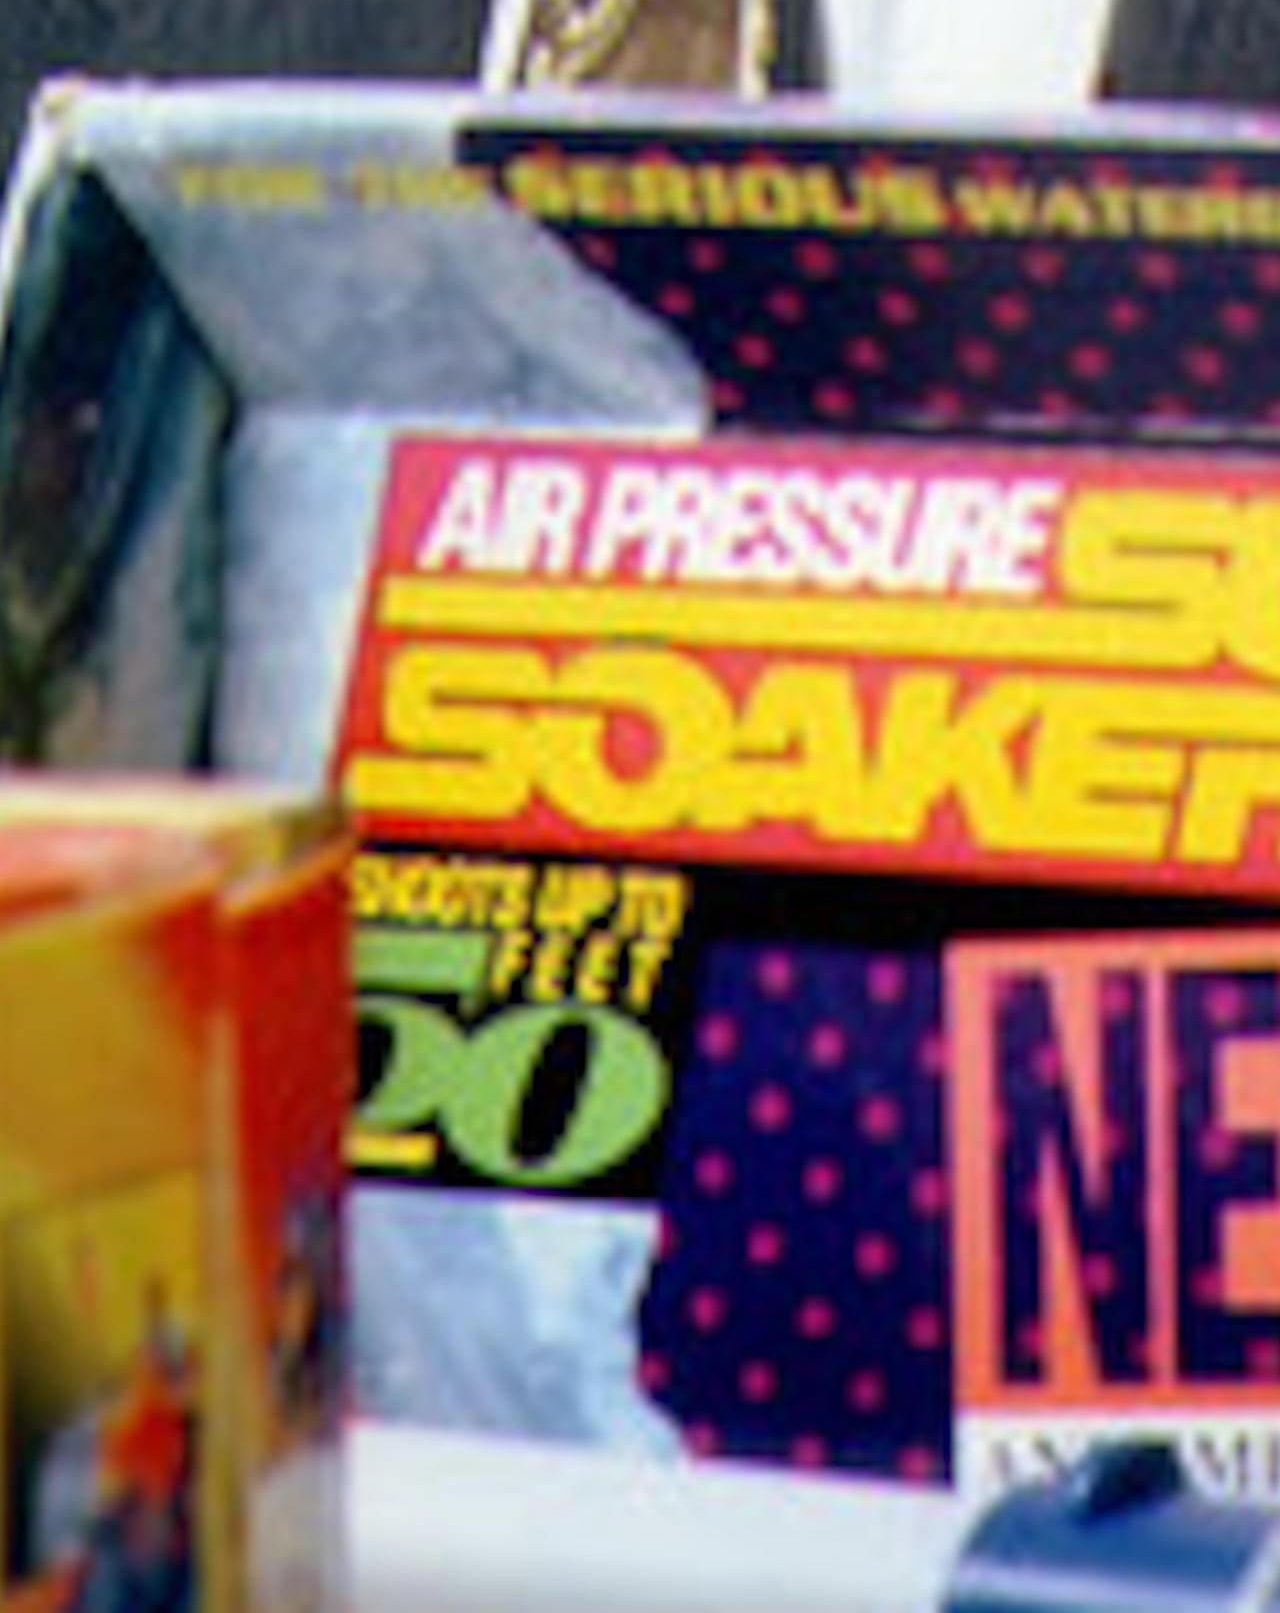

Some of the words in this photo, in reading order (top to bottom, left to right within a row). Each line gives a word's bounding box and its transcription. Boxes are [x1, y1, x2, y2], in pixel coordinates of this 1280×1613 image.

[505, 160, 944, 231] SERIOUS
[418, 463, 582, 573] AIR
[590, 473, 1056, 591] PRESSURE
[533, 861, 620, 937] UP
[618, 869, 688, 943] TO
[488, 929, 676, 1015] FEET
